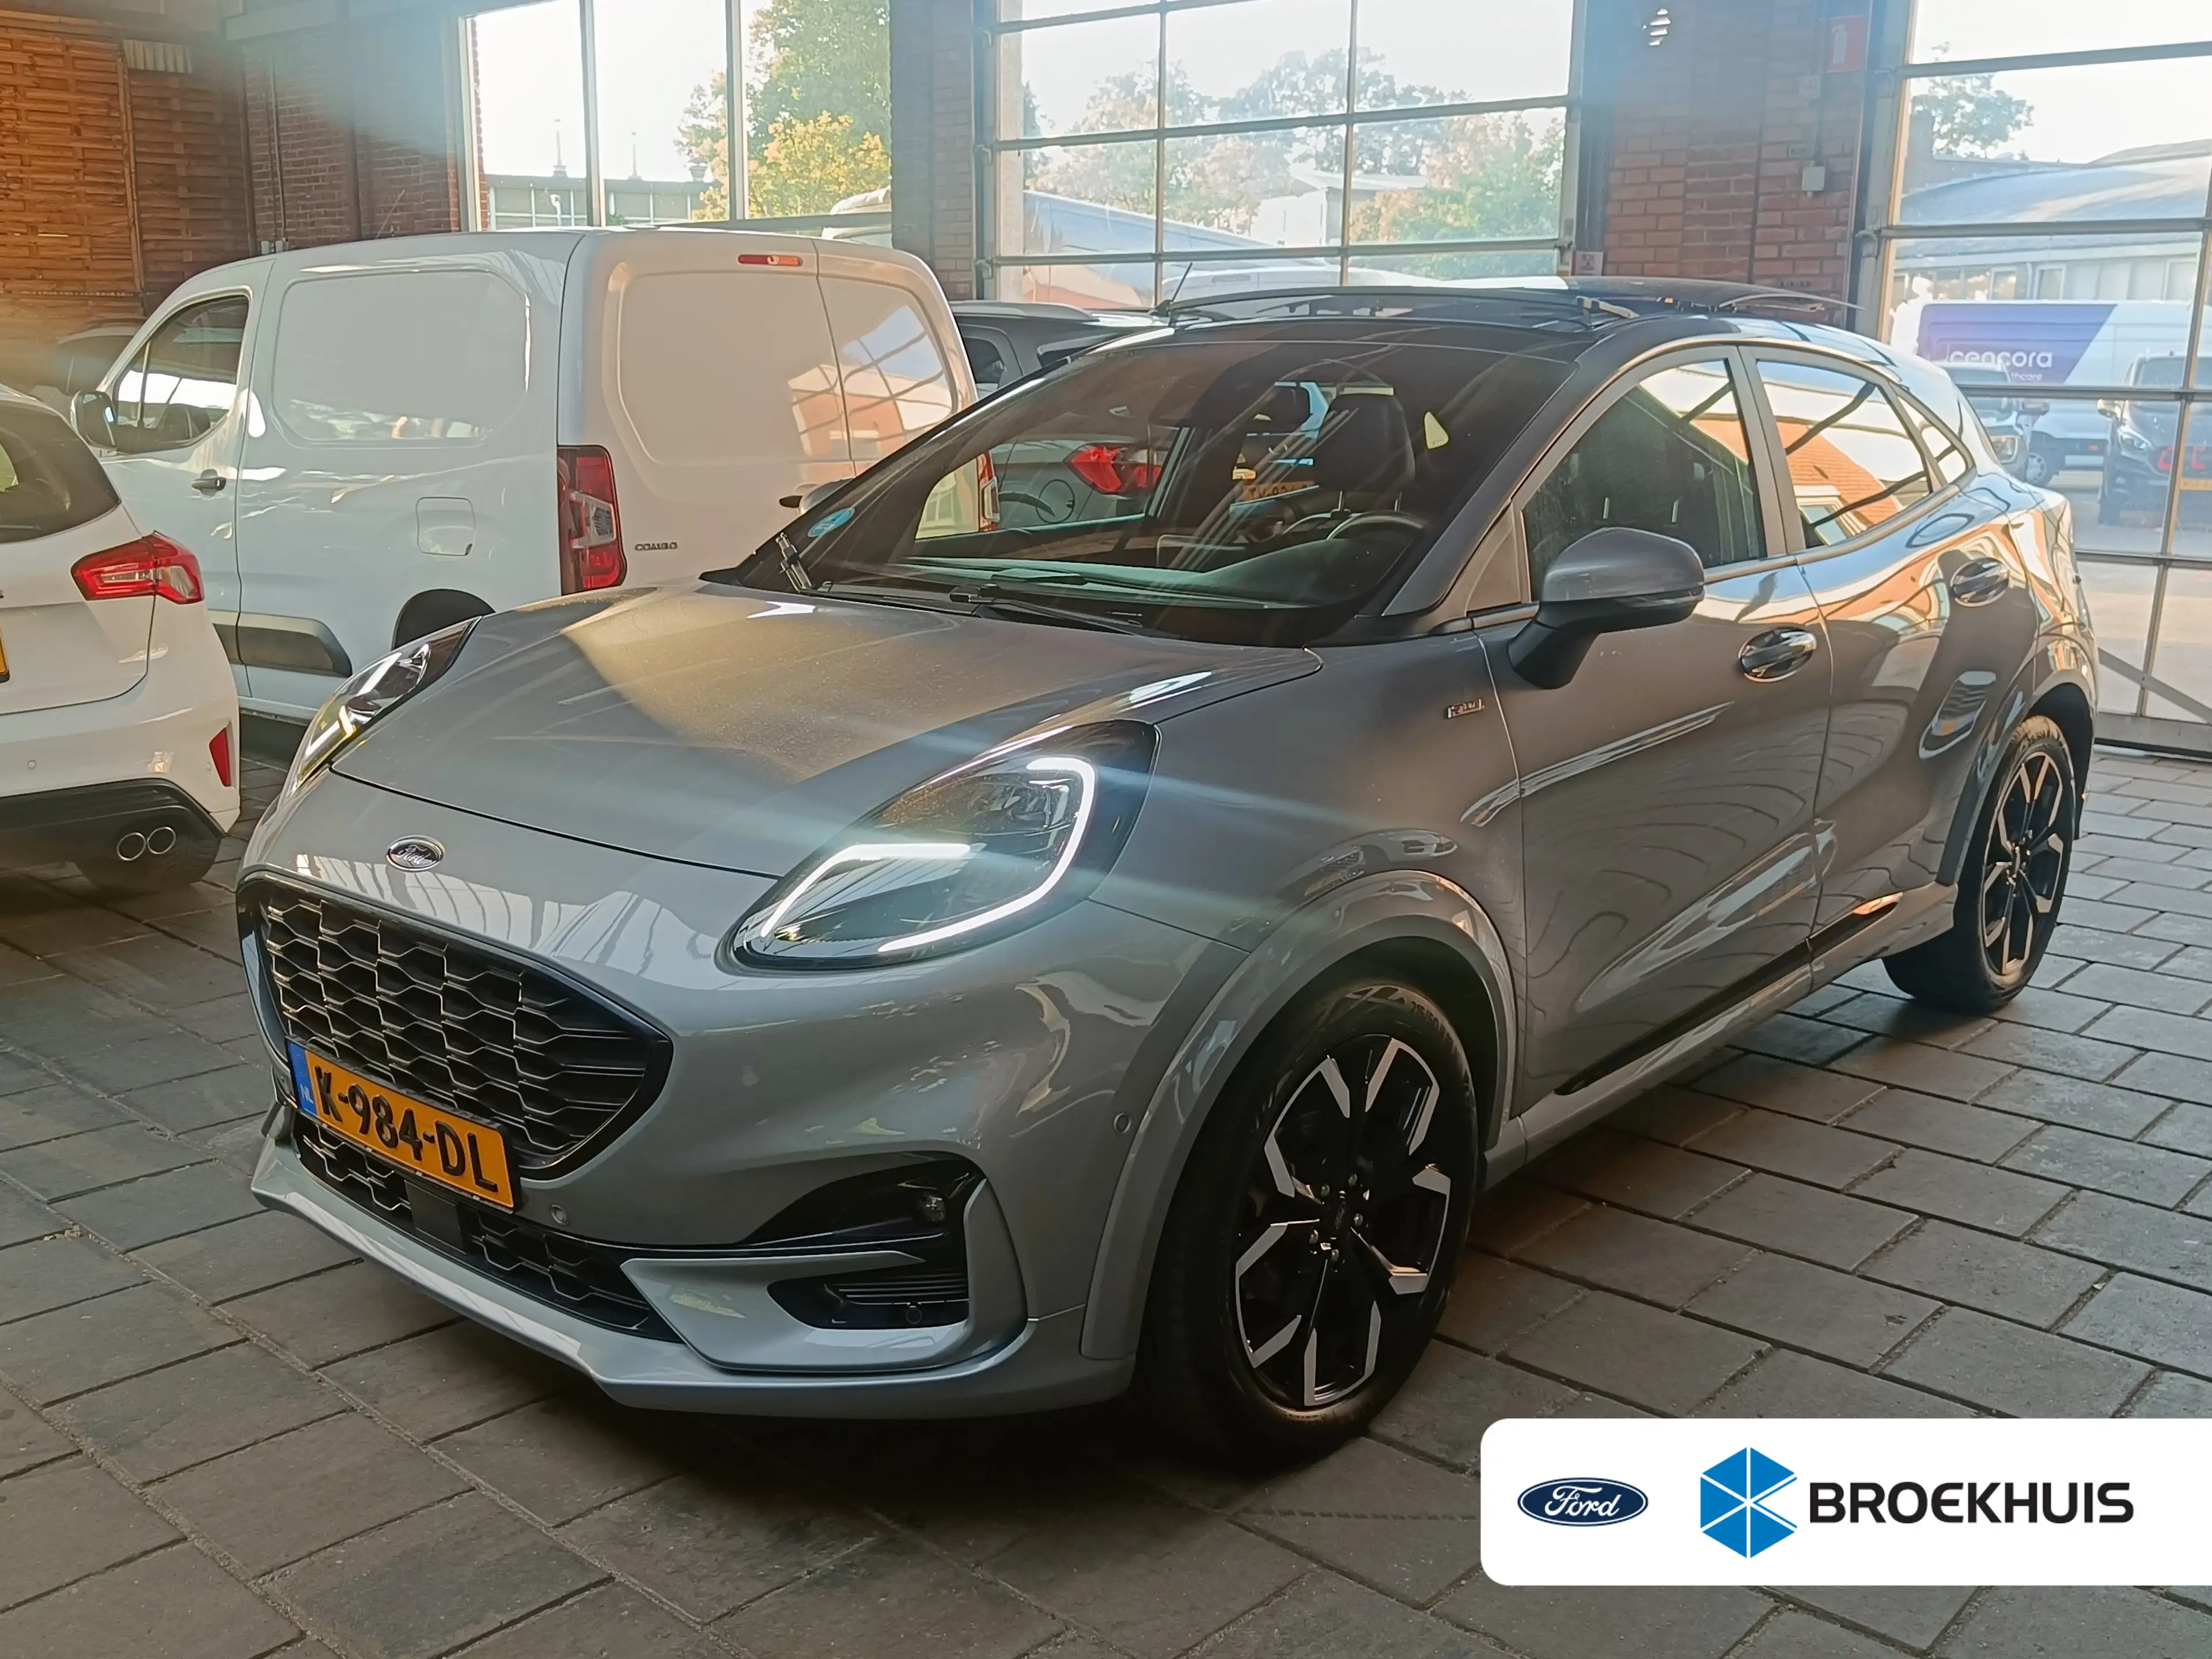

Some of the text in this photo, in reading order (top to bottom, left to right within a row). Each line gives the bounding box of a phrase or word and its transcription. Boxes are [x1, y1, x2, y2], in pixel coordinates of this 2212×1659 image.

[1950, 351, 2052, 368] cencora
[396, 844, 431, 865] Ford
[300, 1083, 314, 1104] NL
[314, 1065, 498, 1192] K-984-DL
